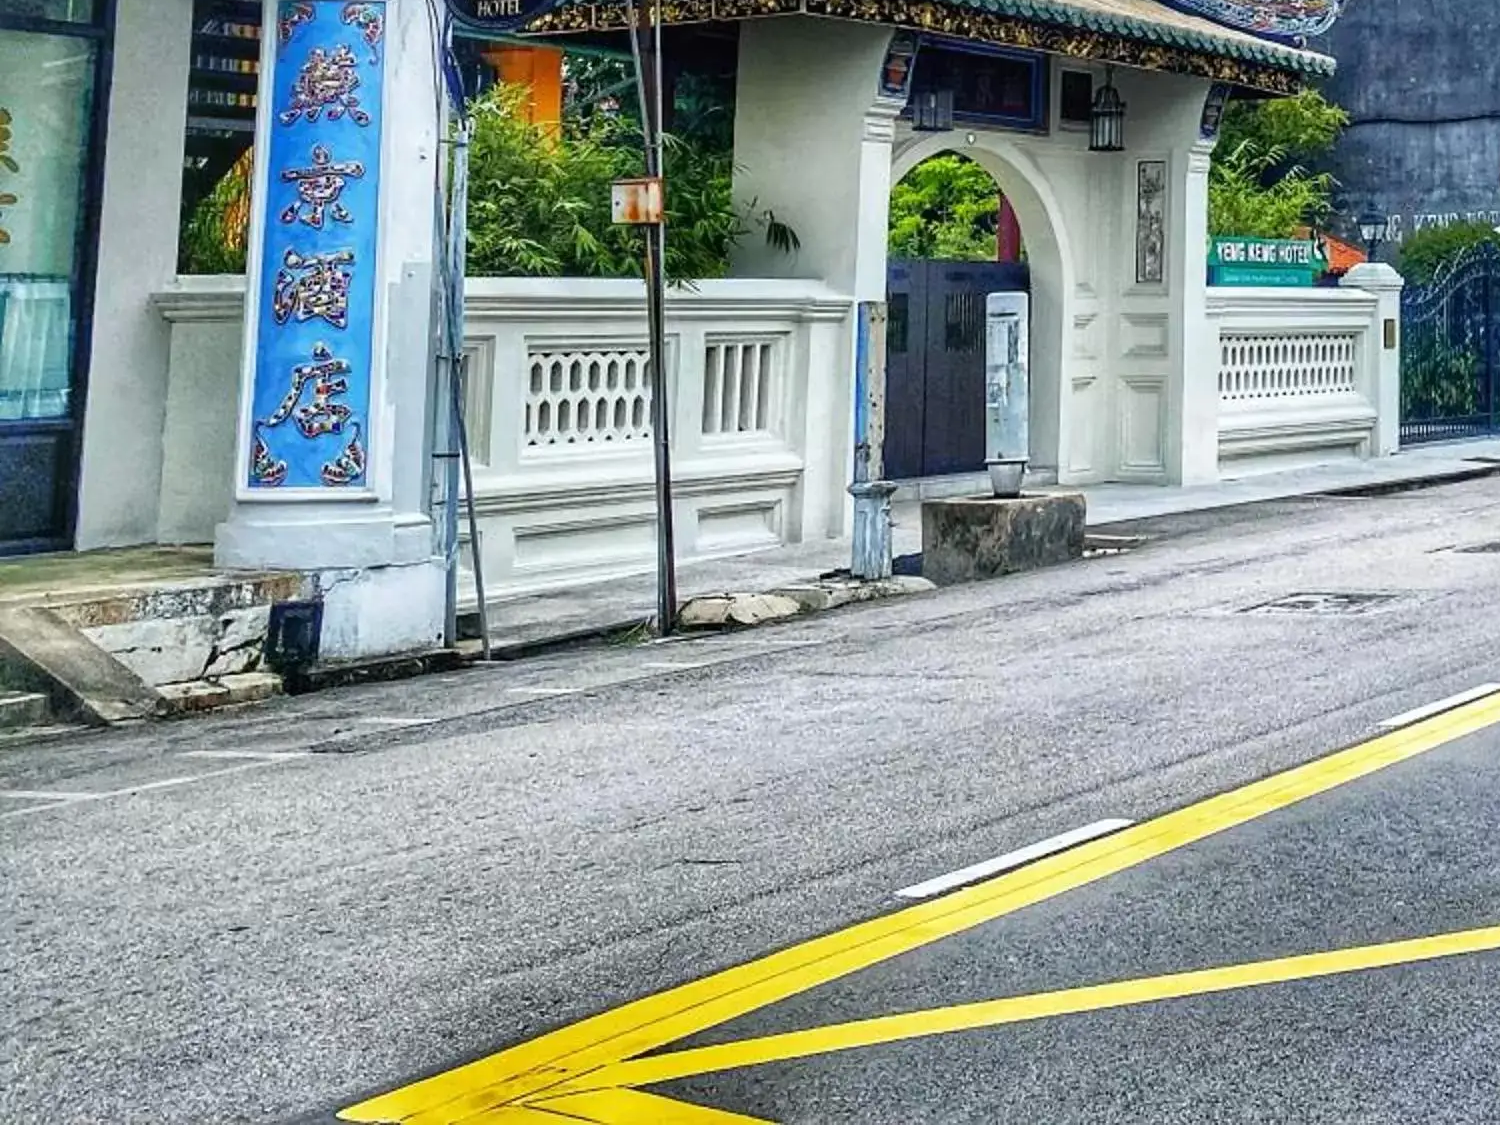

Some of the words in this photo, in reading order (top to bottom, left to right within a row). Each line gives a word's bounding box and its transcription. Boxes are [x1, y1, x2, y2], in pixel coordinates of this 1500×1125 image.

[1215, 241, 1245, 262] YENG
[1248, 242, 1277, 263] KENG
[1279, 244, 1309, 264] HOTEL
